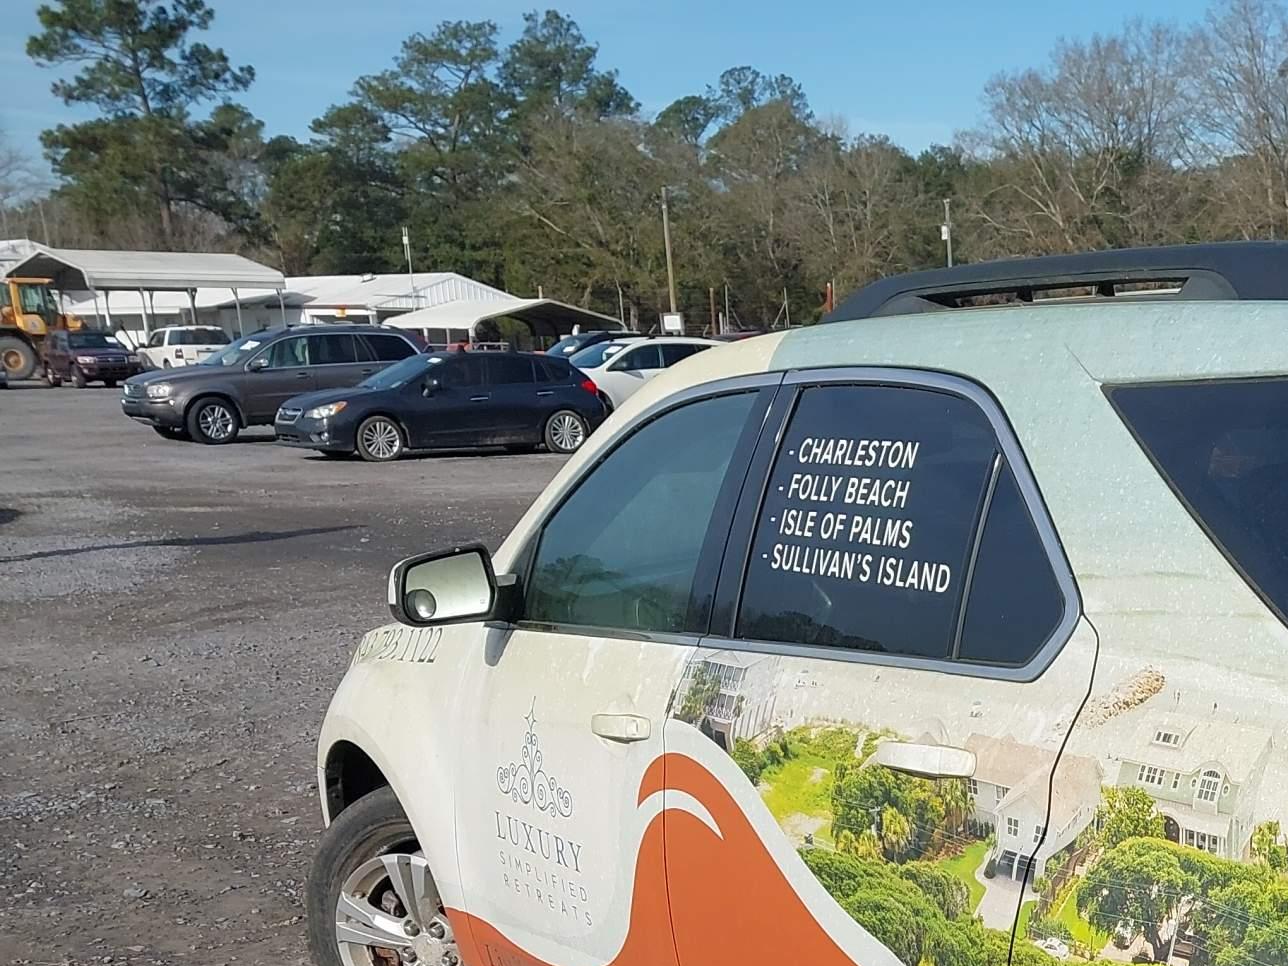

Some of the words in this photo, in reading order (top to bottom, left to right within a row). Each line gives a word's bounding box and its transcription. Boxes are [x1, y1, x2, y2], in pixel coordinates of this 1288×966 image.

[798, 437, 920, 469] CHARLESTON
[787, 473, 843, 503] FOLLY
[844, 476, 911, 509] BEACH
[779, 508, 818, 538] ISLE
[820, 512, 847, 541] OF
[849, 515, 913, 550] PALMS
[770, 543, 873, 583] SULLIVAN'S
[877, 556, 951, 594] ISLAND
[495, 810, 583, 874] LUXURY
[499, 850, 588, 903] SIMPLIFIED
[503, 872, 593, 927] RETREATS
